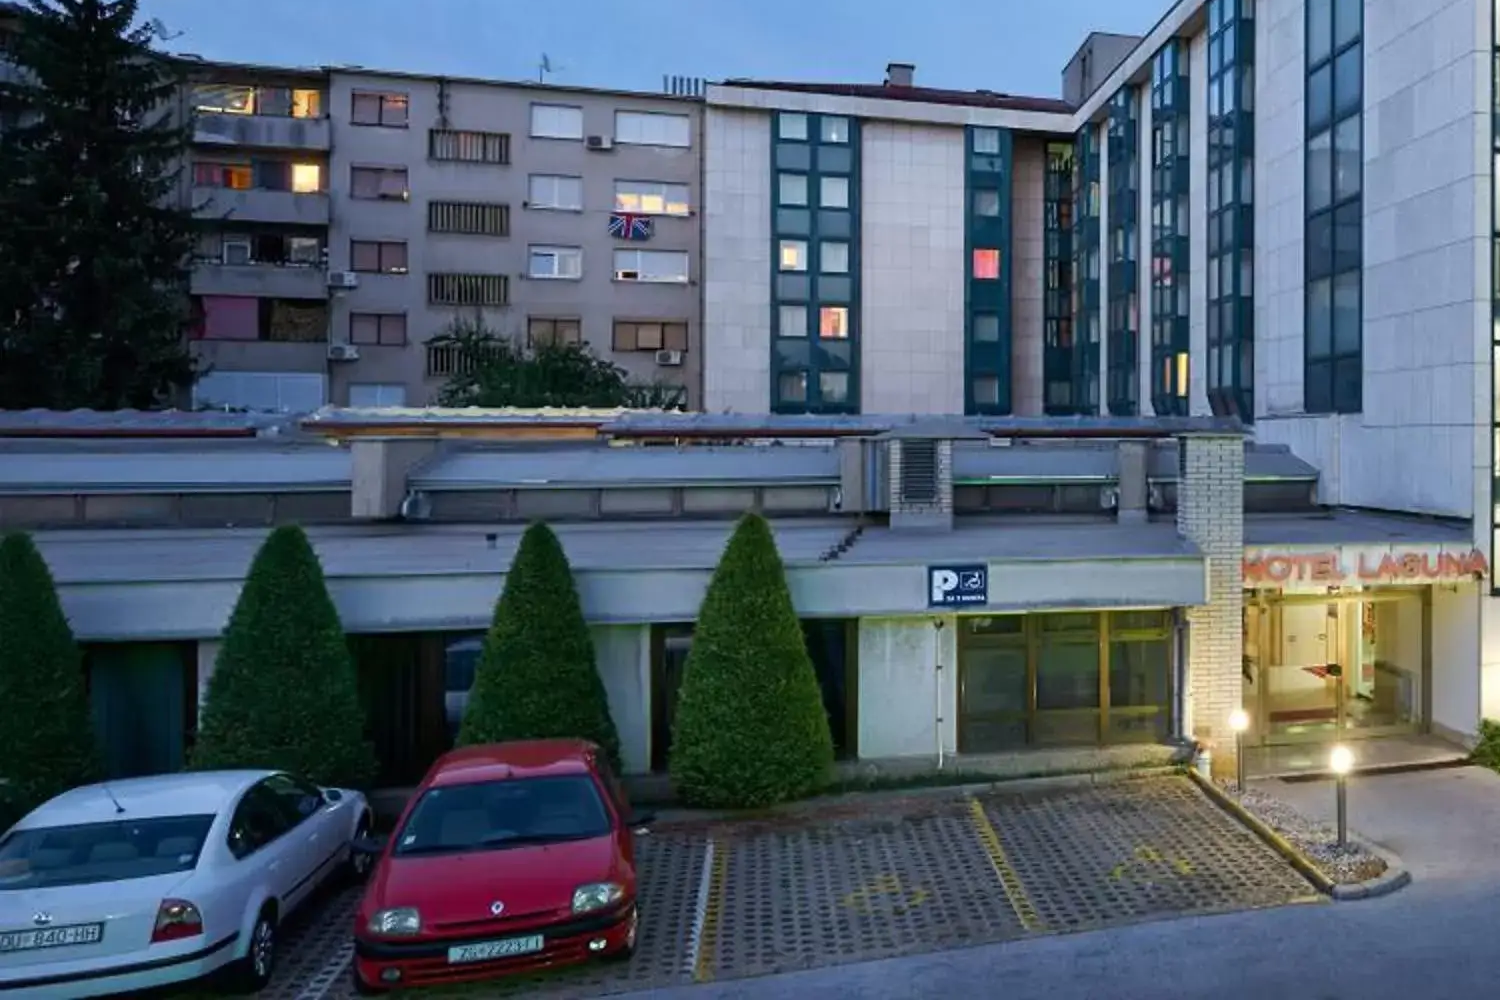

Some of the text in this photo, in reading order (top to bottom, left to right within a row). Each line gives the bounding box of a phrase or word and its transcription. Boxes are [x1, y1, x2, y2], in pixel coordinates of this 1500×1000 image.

[1242, 549, 1488, 581] HOTEL LAGUNA
[932, 569, 959, 601] P
